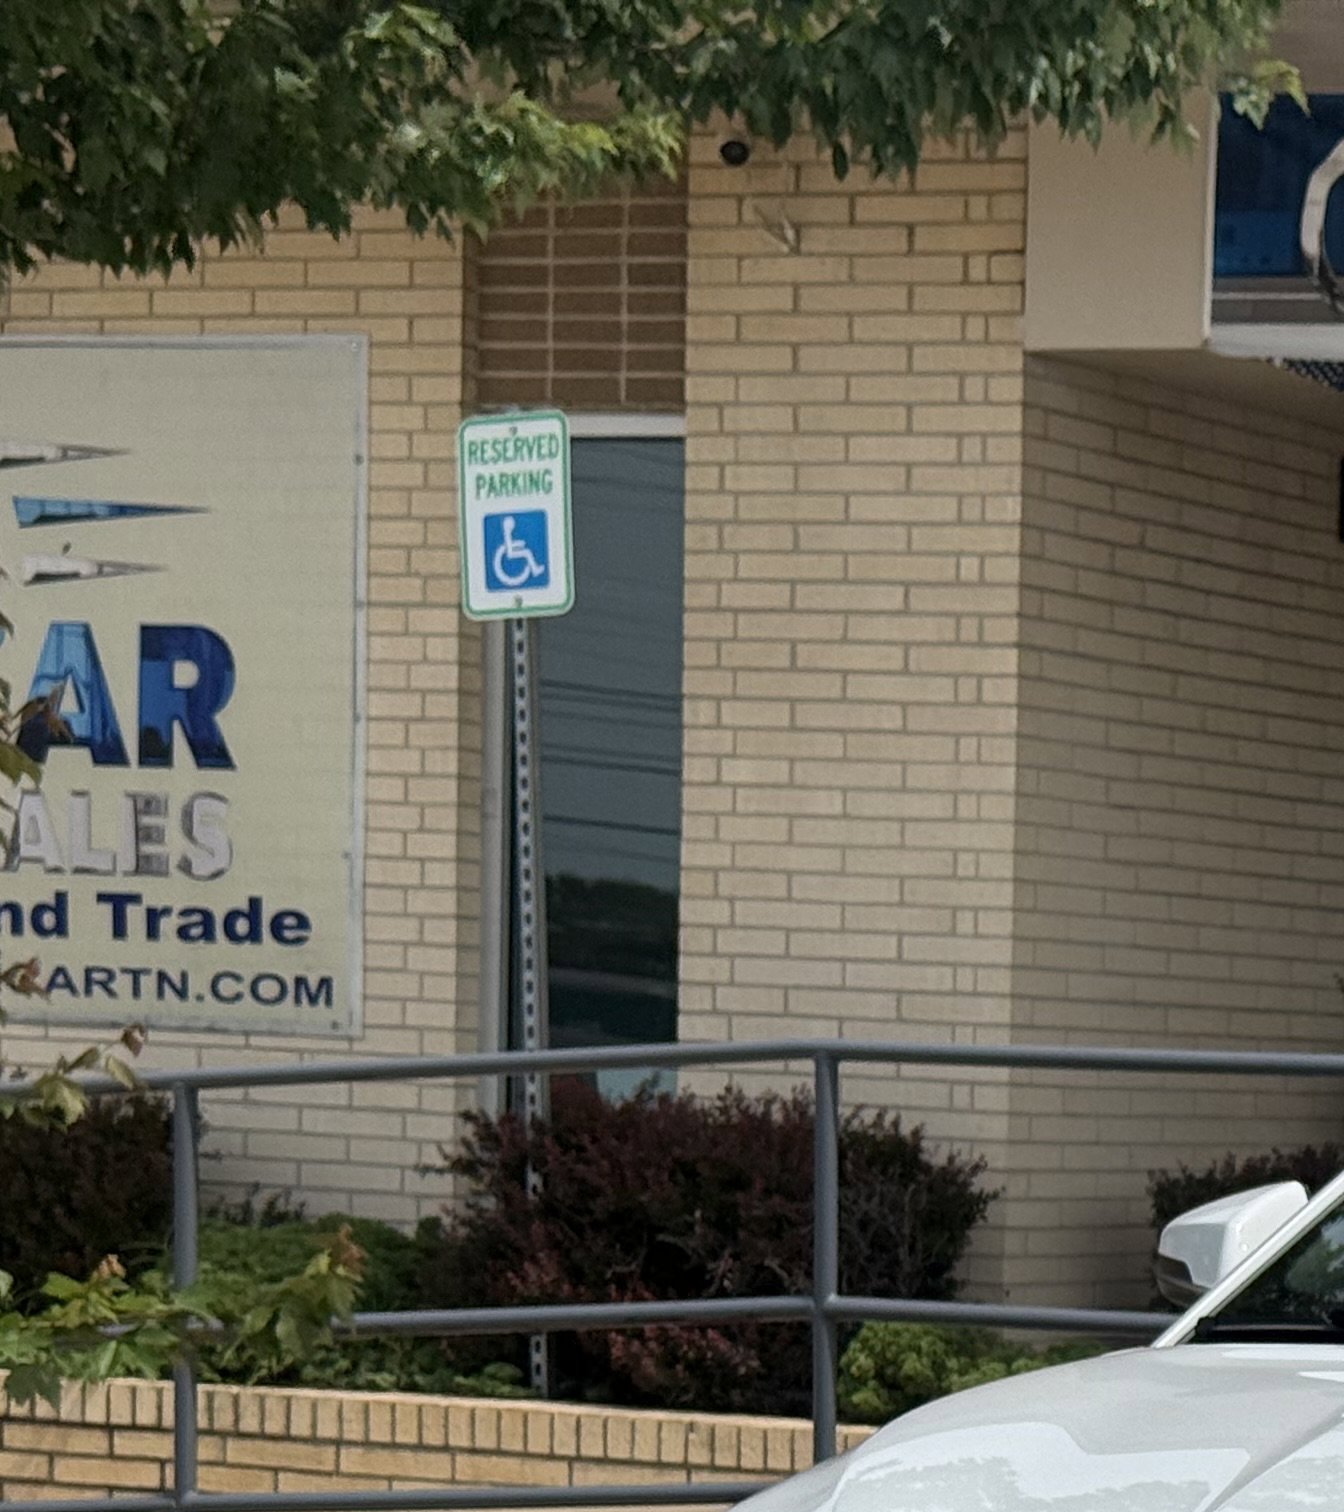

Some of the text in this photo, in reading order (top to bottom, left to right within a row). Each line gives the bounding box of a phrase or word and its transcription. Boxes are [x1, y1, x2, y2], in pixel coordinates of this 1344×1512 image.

[468, 434, 559, 465] RESERVED
[475, 469, 553, 498] PARKING
[0, 621, 237, 769] AR
[0, 789, 233, 881] ALES
[96, 892, 312, 946] Trade
[44, 965, 335, 1008] ARTN.COM
